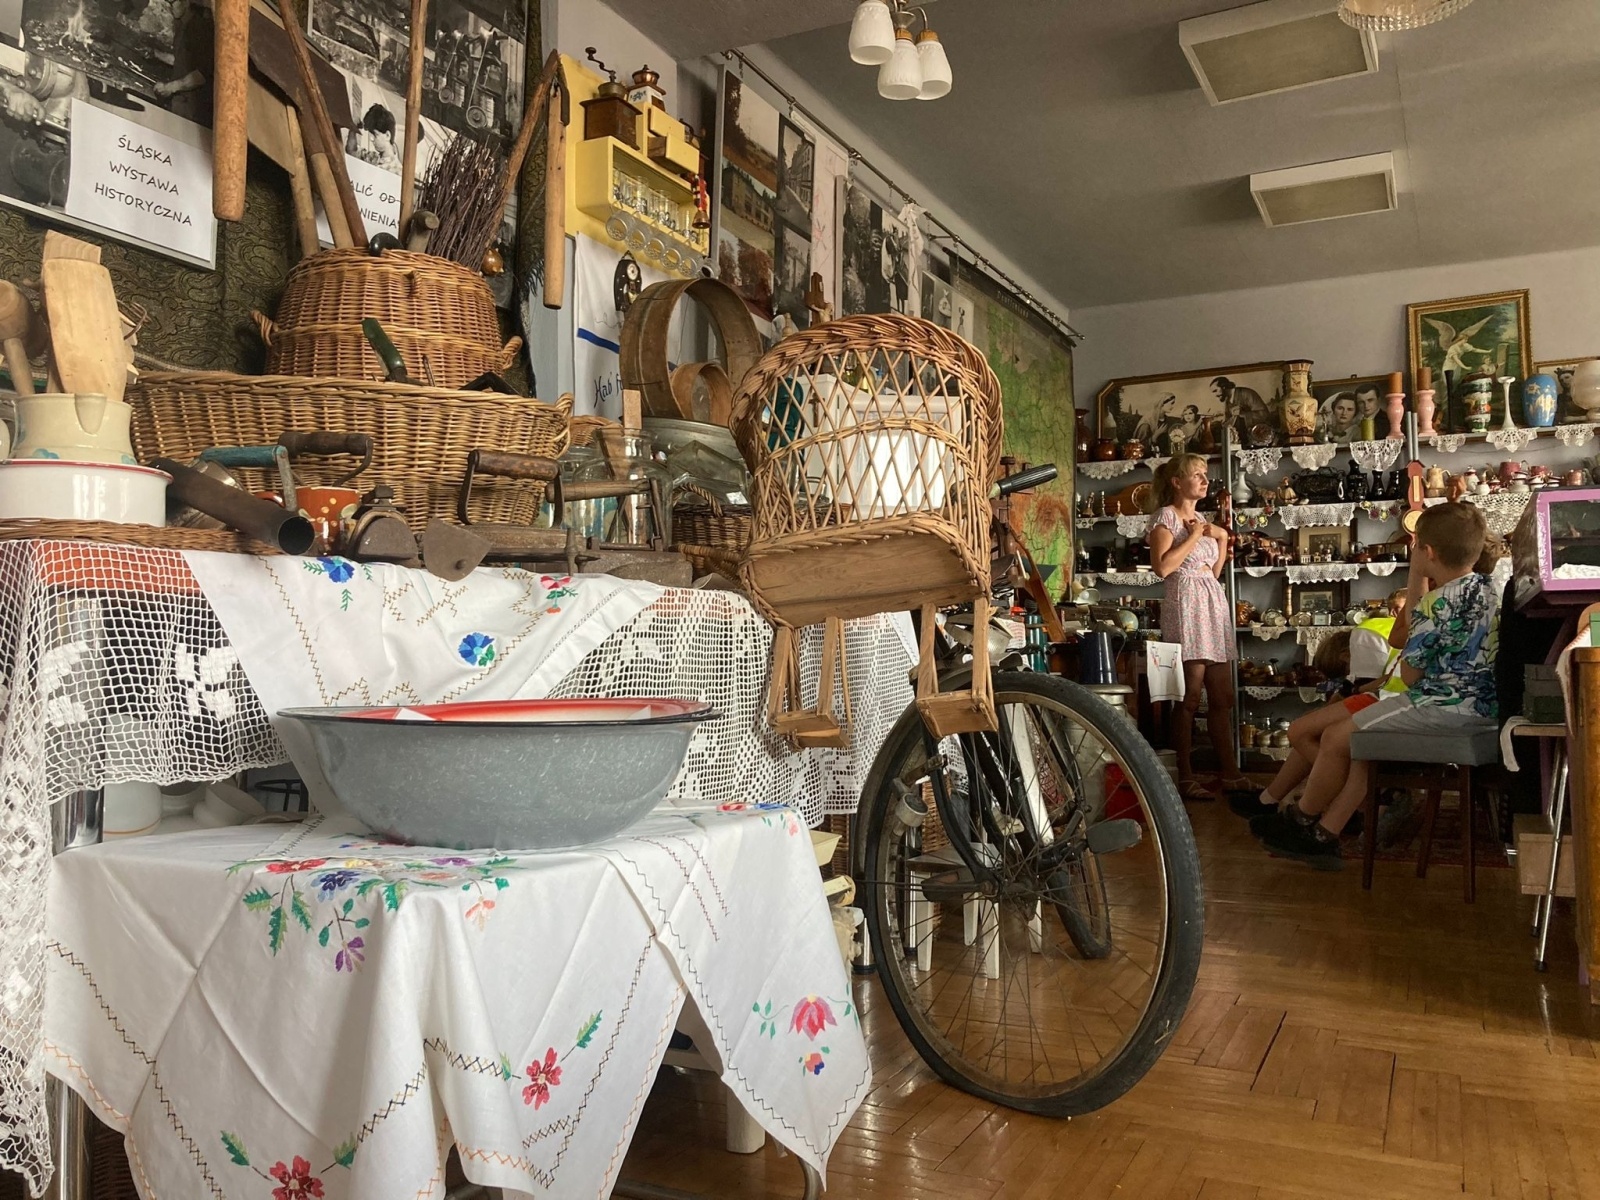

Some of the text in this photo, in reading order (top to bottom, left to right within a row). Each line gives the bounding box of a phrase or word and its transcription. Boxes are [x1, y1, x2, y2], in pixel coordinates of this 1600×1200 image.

[118, 134, 173, 167] ŚLĄSKA
[109, 160, 180, 196] WYSTAWA
[94, 182, 193, 227] HISTORYCZNA
[360, 207, 398, 229] NIENIA
